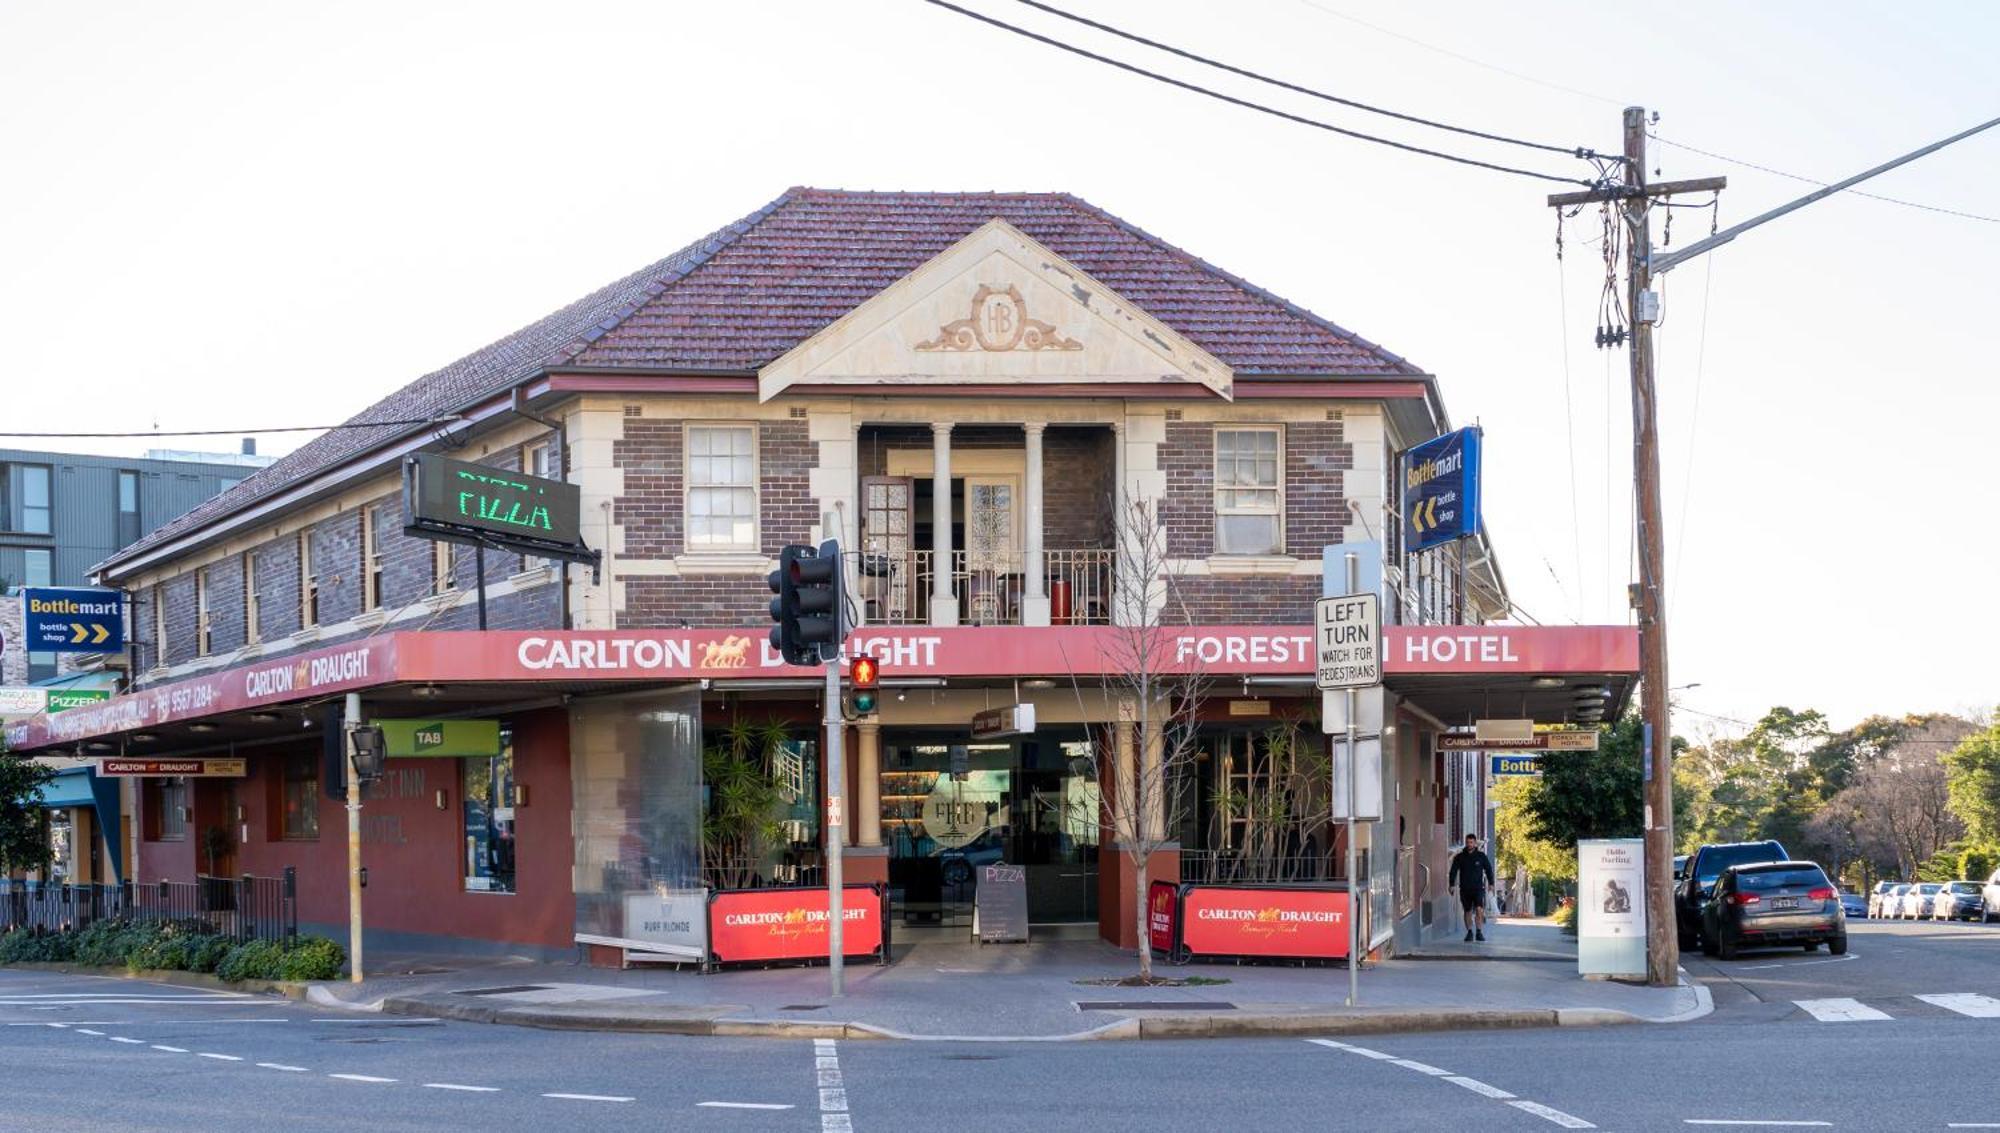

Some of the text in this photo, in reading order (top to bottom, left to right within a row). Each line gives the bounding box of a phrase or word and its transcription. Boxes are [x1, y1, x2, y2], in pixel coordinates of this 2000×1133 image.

[1407, 449, 1462, 490] Bottlemart
[1437, 490, 1456, 507] bottle
[1439, 509, 1455, 523] shop
[31, 599, 118, 615] Bottlemart
[1325, 602, 1367, 623] LEFT
[39, 623, 68, 631] bottle
[1324, 624, 1369, 645] TURN
[42, 633, 66, 643] shop
[518, 636, 942, 669] CARLTON DUGHT
[1176, 636, 1313, 663] FOREST
[1406, 635, 1519, 662] HOTEL
[1322, 648, 1350, 664] WATCH
[1354, 646, 1373, 660] FOR
[246, 648, 370, 698] CARLTON DRAUGHT
[1319, 664, 1376, 681] PEDESTRIANS
[50, 695, 105, 708] PIZZERI
[416, 732, 442, 745] TAB
[108, 763, 146, 772] CARLTON
[159, 763, 199, 772] DRAUGHT
[725, 908, 867, 925] CARLTON DRAGHT
[1198, 908, 1343, 923] CARLTON DRAUGHT
